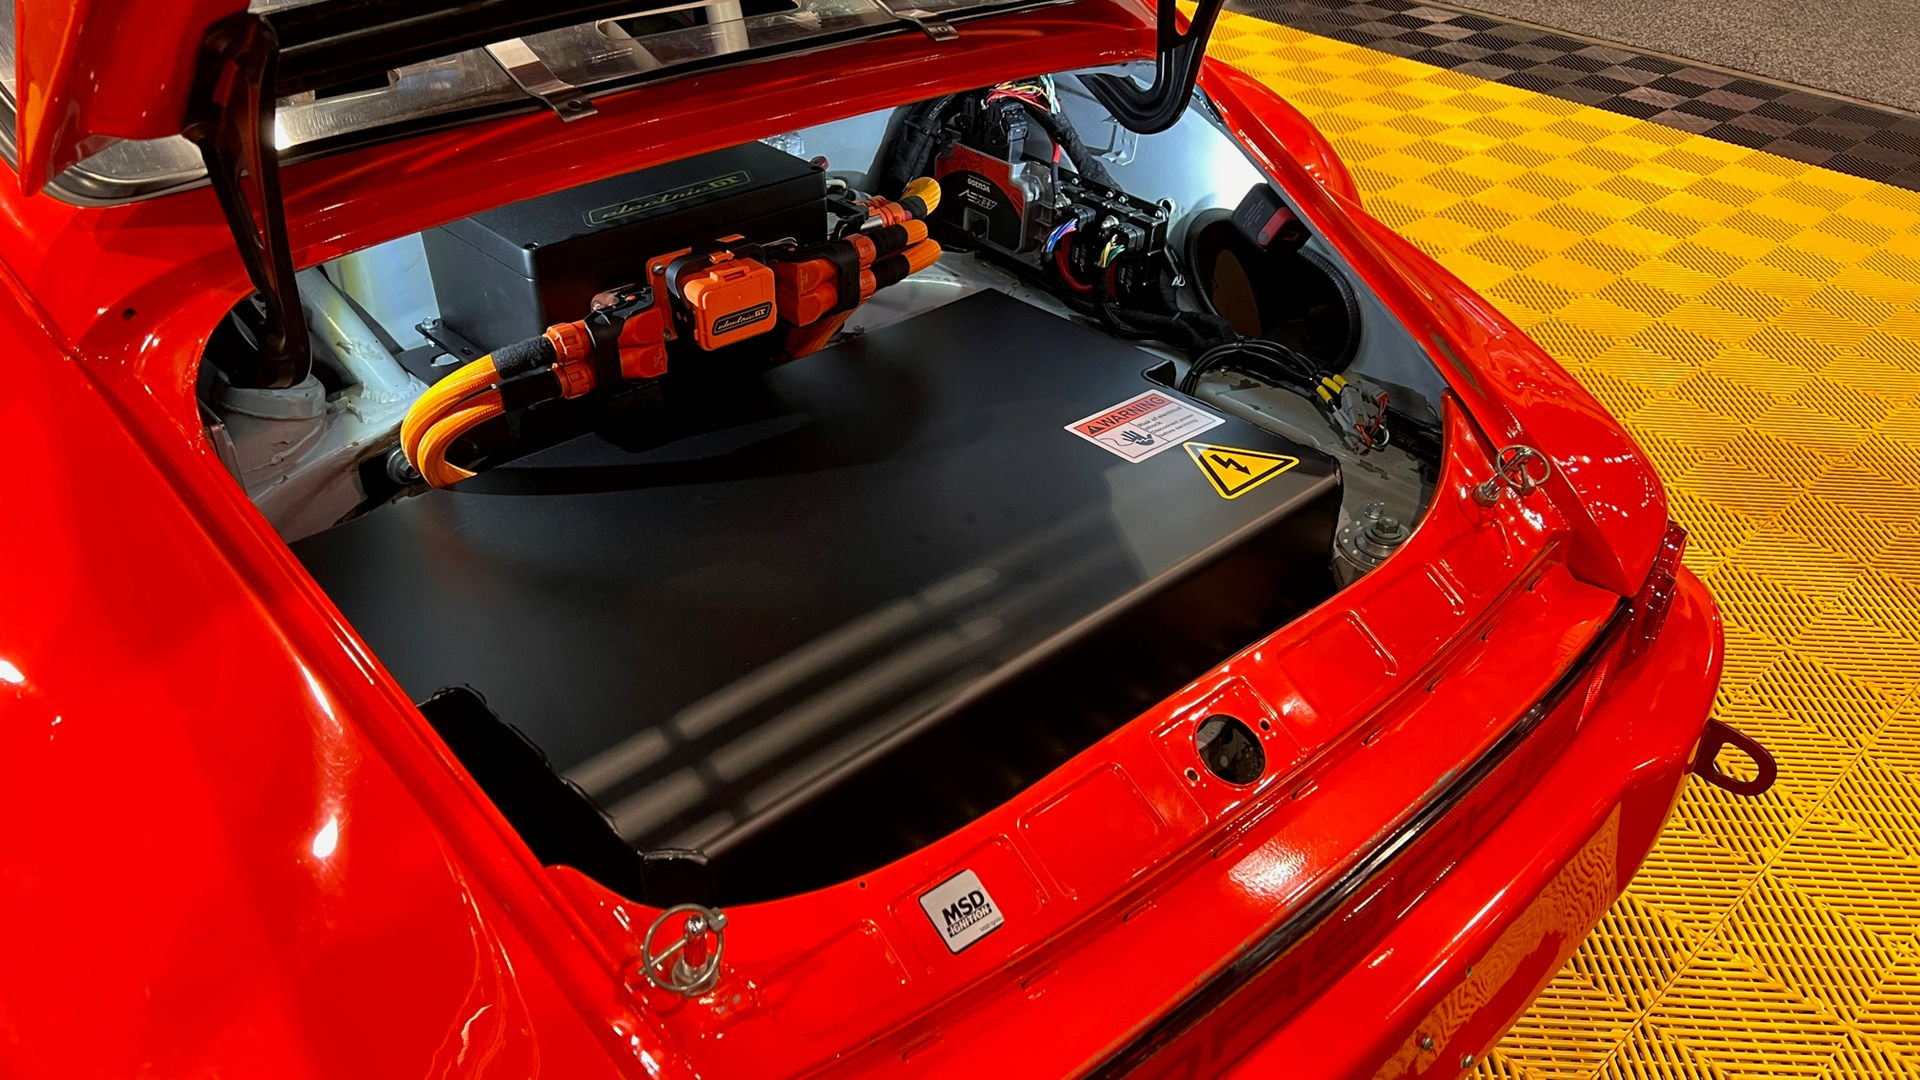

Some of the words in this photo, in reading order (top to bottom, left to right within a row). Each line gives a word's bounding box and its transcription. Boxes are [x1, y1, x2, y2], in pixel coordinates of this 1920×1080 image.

[1095, 396, 1166, 427] WARNING
[941, 889, 985, 926] MSD
[948, 904, 992, 936] IGNITION
